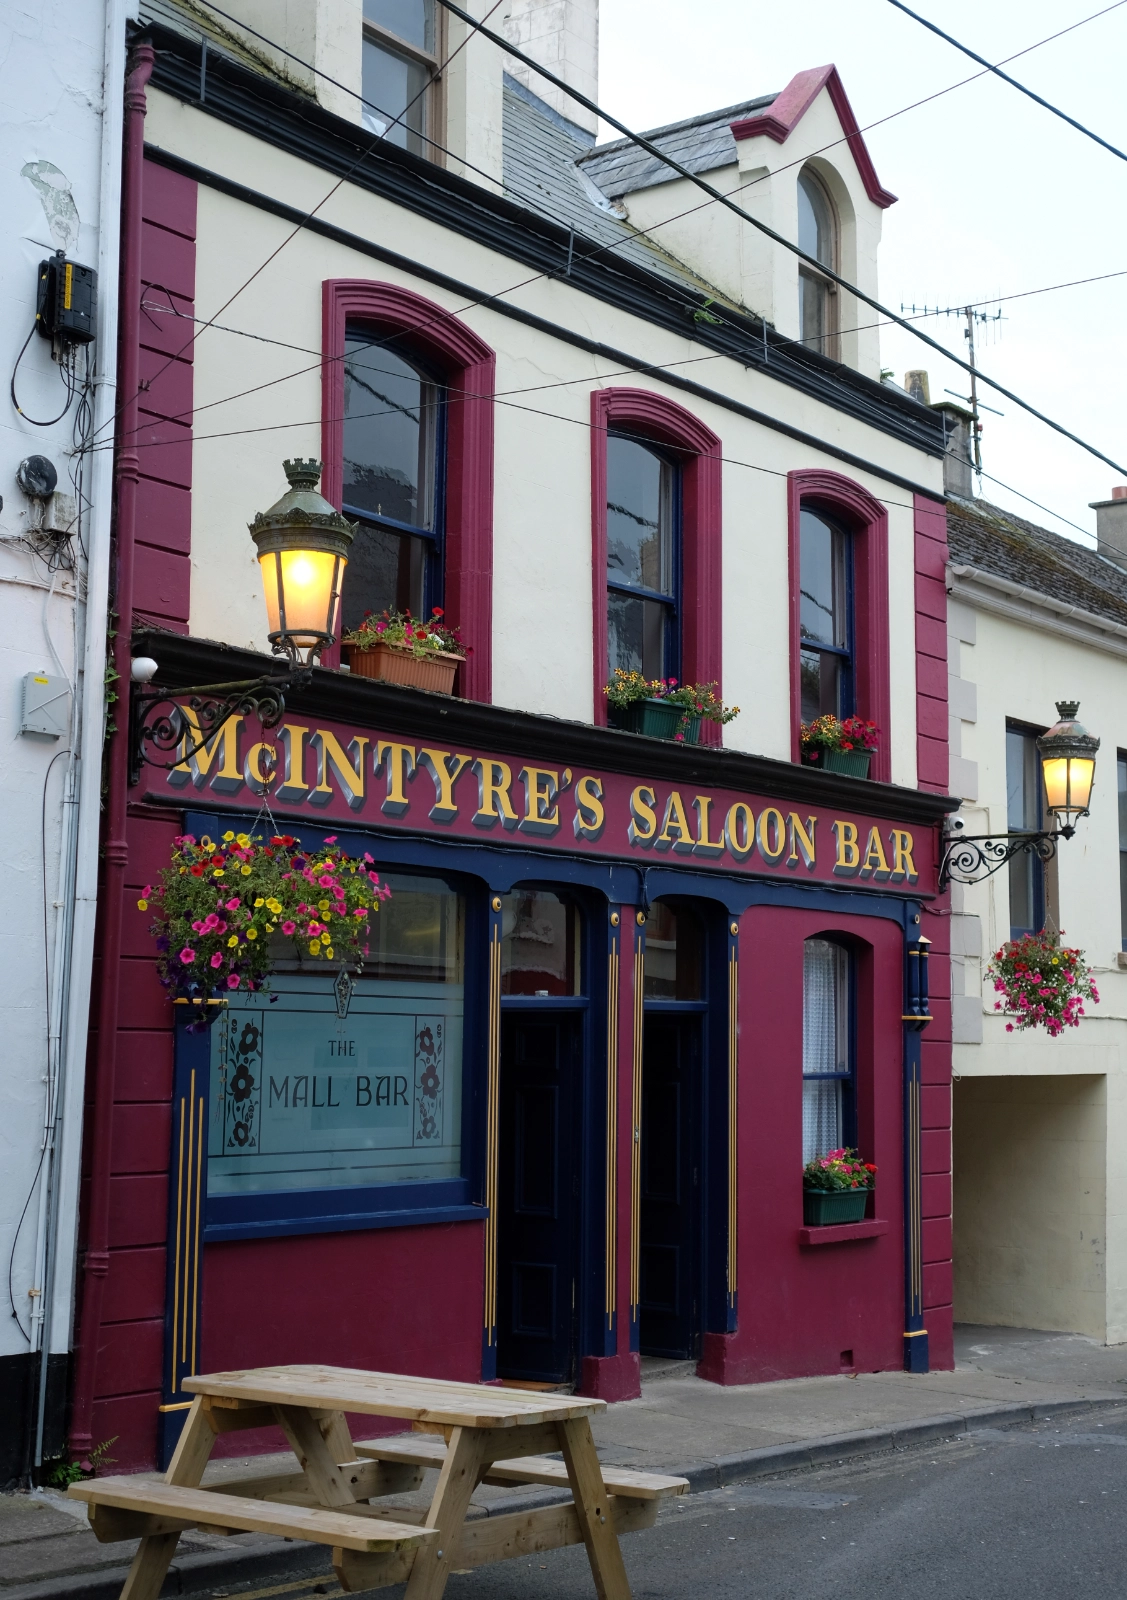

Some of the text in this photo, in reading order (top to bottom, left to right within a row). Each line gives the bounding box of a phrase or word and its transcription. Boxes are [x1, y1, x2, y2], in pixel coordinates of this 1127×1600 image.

[167, 705, 919, 884] McINTYRE'S SALOON BAR
[327, 1040, 356, 1057] THE
[268, 1075, 410, 1108] MALL BAR
